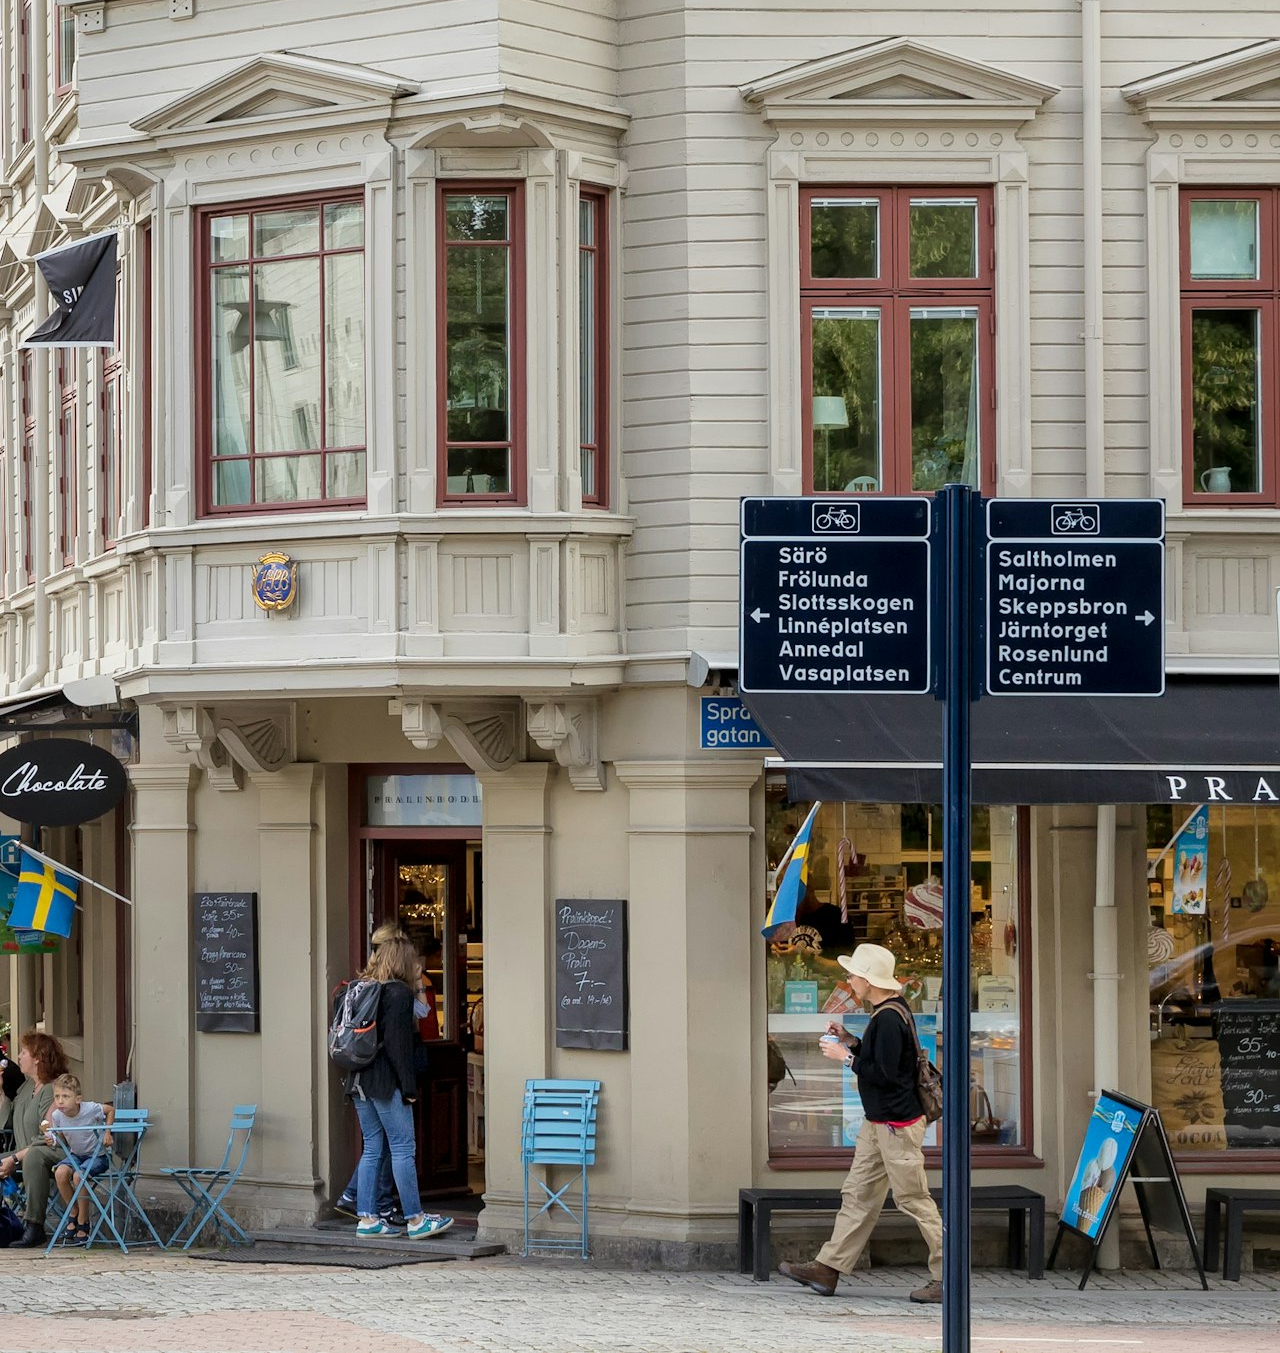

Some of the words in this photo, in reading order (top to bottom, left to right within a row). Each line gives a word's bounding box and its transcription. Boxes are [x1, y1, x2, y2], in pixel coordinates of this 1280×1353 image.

[779, 547, 827, 563] Särö
[999, 551, 1116, 567] Saltholmen
[779, 571, 868, 587] Frölunda
[999, 574, 1085, 594] Majorna
[778, 594, 914, 614] Slottsskogen
[999, 598, 1127, 618] Skeppsbron
[778, 617, 908, 637] Linnéplatsen
[999, 622, 1108, 641] Järntorget
[779, 641, 864, 657] Annedal
[999, 645, 1108, 662] Rosenlund
[779, 665, 910, 684] Vasaplatsen
[999, 669, 1082, 685] Centrum
[707, 703, 751, 723] Sprä
[707, 727, 760, 746] gatan
[2, 762, 108, 796] Chocolate
[1166, 776, 1279, 800] PRA
[564, 932, 606, 956] Dagens
